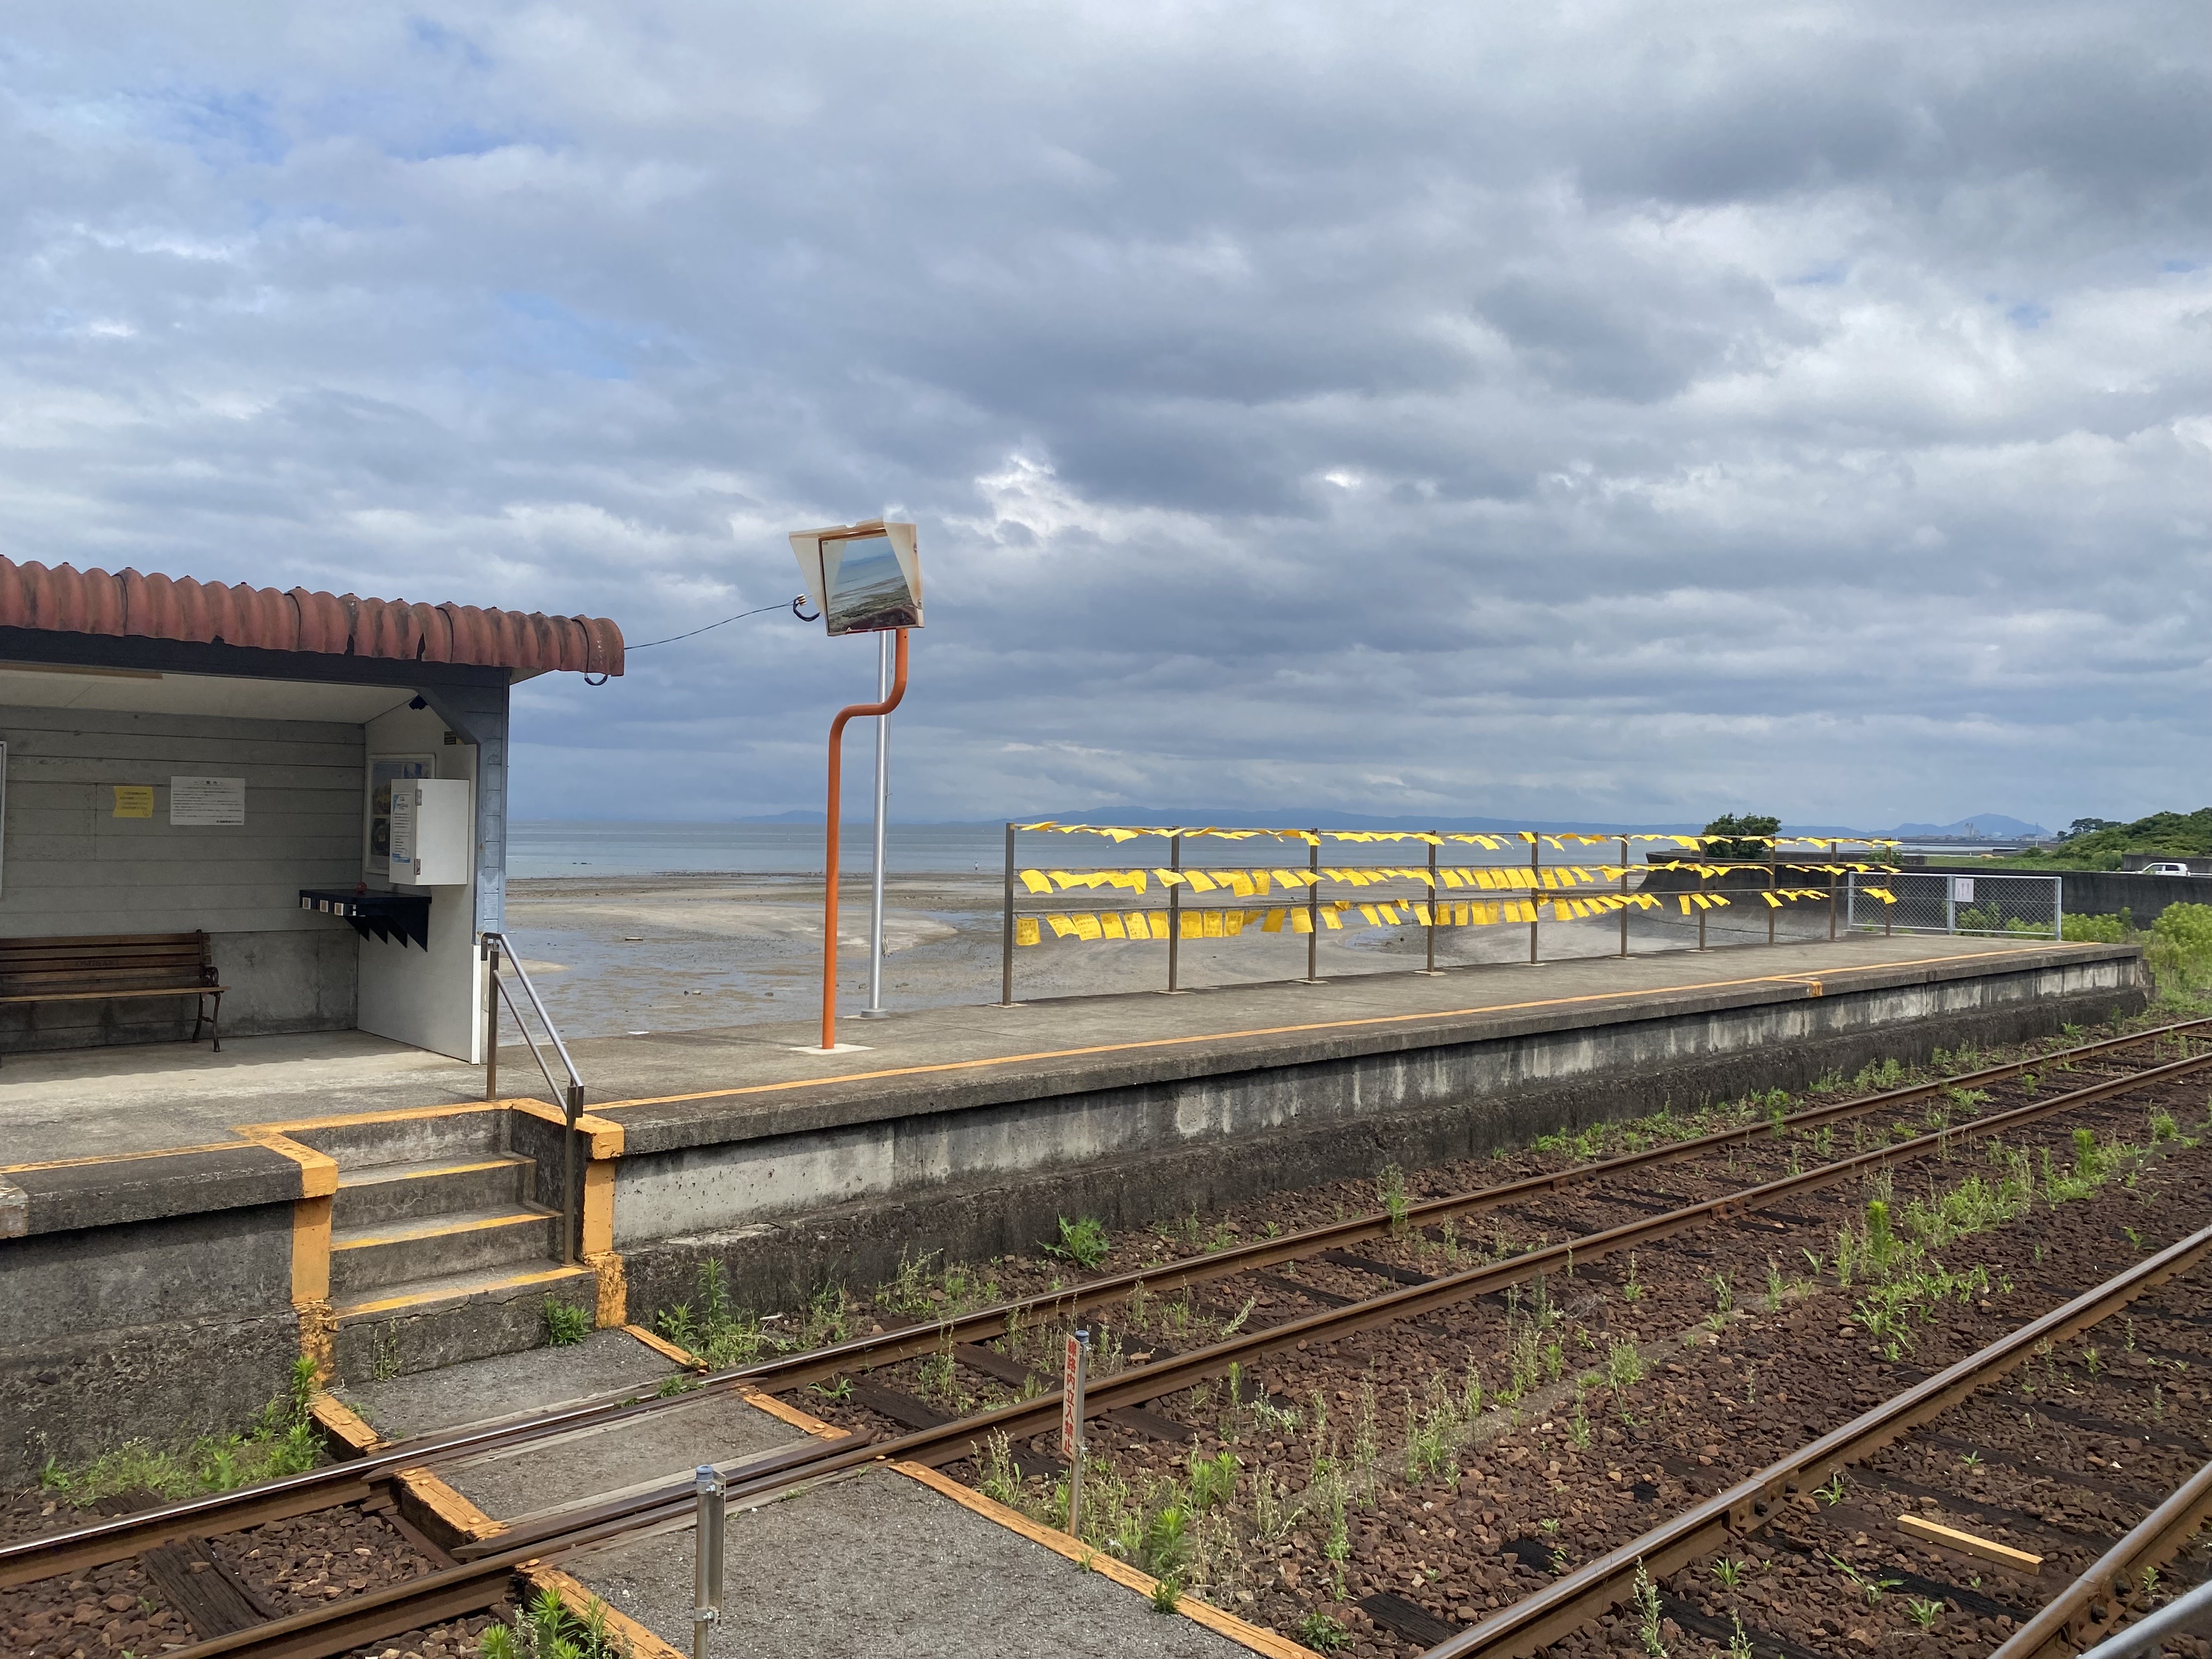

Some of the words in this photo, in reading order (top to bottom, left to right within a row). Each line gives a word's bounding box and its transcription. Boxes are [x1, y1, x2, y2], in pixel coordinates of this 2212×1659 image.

[1064, 1339, 1077, 1456] 線路内立入禁止
